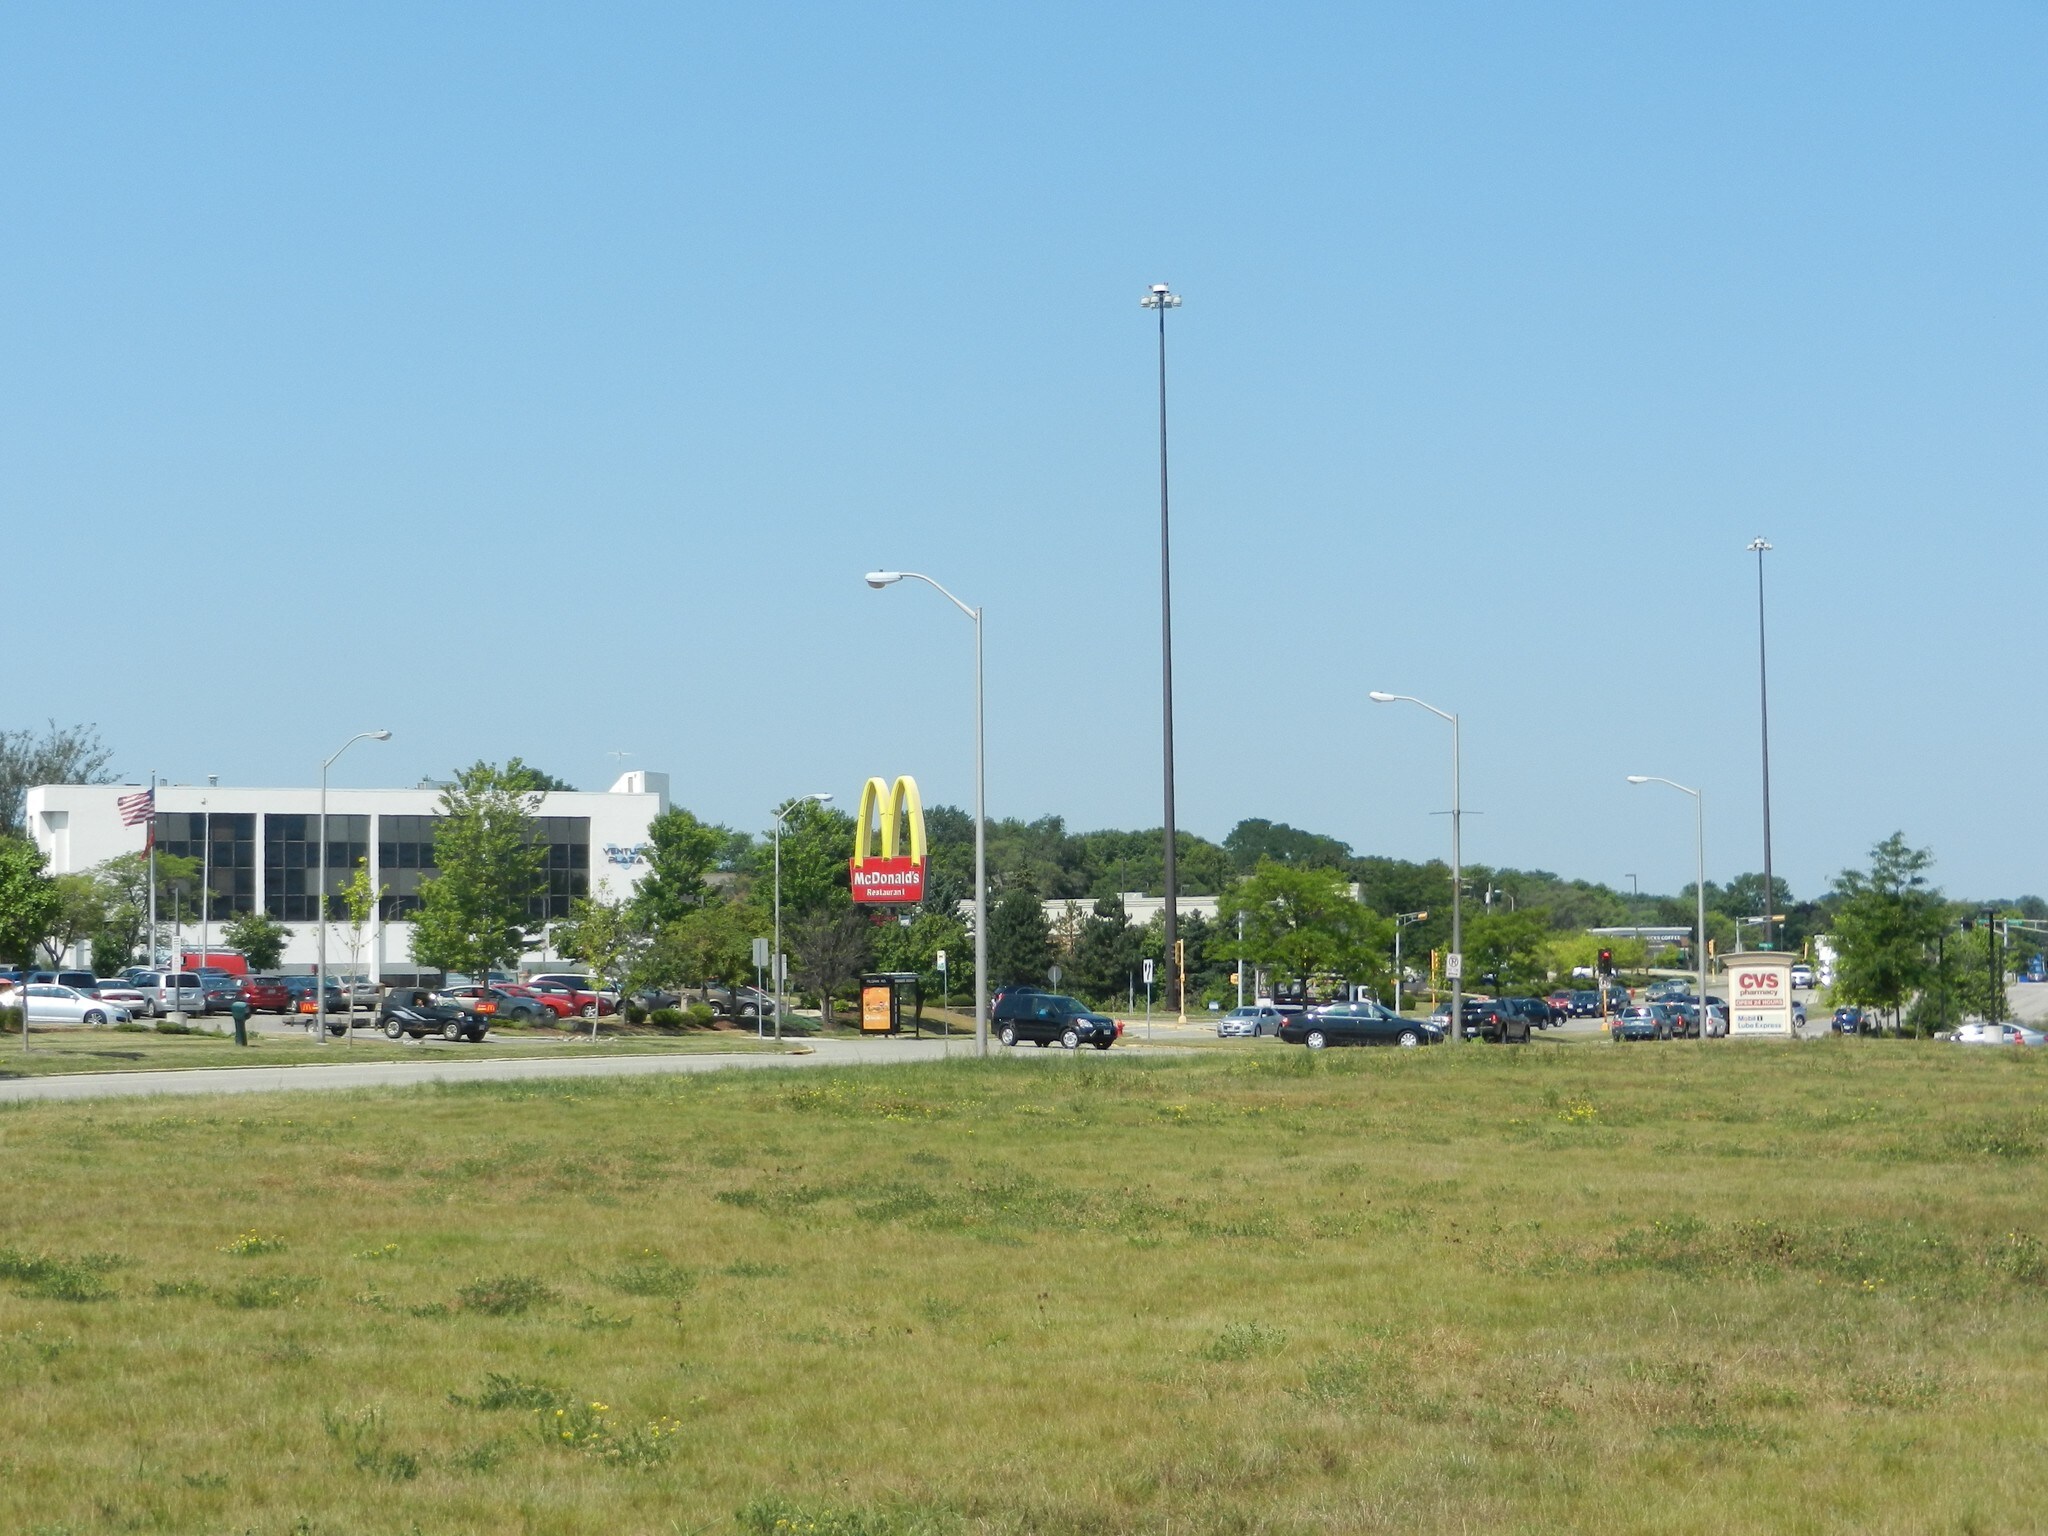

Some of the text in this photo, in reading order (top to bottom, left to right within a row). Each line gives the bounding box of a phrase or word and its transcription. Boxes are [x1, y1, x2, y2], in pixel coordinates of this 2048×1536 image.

[602, 847, 644, 855] VENTUR
[608, 856, 644, 864] PLAZA
[854, 871, 920, 885] McDonald's
[866, 888, 905, 896] Restaurant
[1739, 973, 1779, 989] CVS
